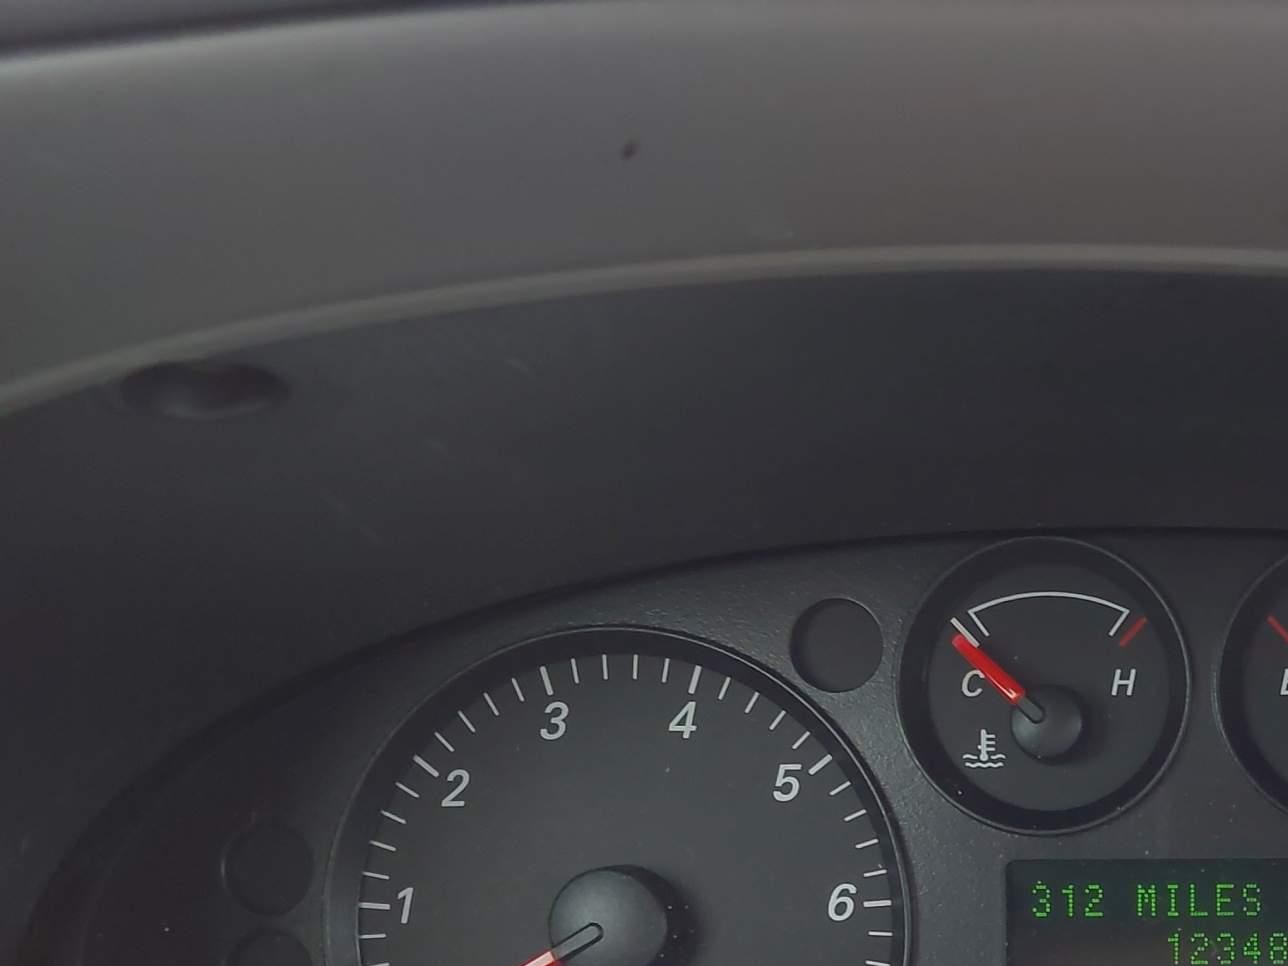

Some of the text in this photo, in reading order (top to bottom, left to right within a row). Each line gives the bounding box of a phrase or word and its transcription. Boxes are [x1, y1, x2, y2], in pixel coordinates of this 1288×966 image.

[961, 669, 985, 697] C
[1111, 668, 1137, 696] H
[540, 701, 570, 740] 3
[668, 701, 697, 739] 4
[441, 769, 471, 807] 2
[773, 763, 803, 802] 5
[397, 887, 414, 925] 1
[827, 883, 857, 921] 6
[1032, 882, 1104, 918] 312
[1136, 882, 1263, 918] MILES
